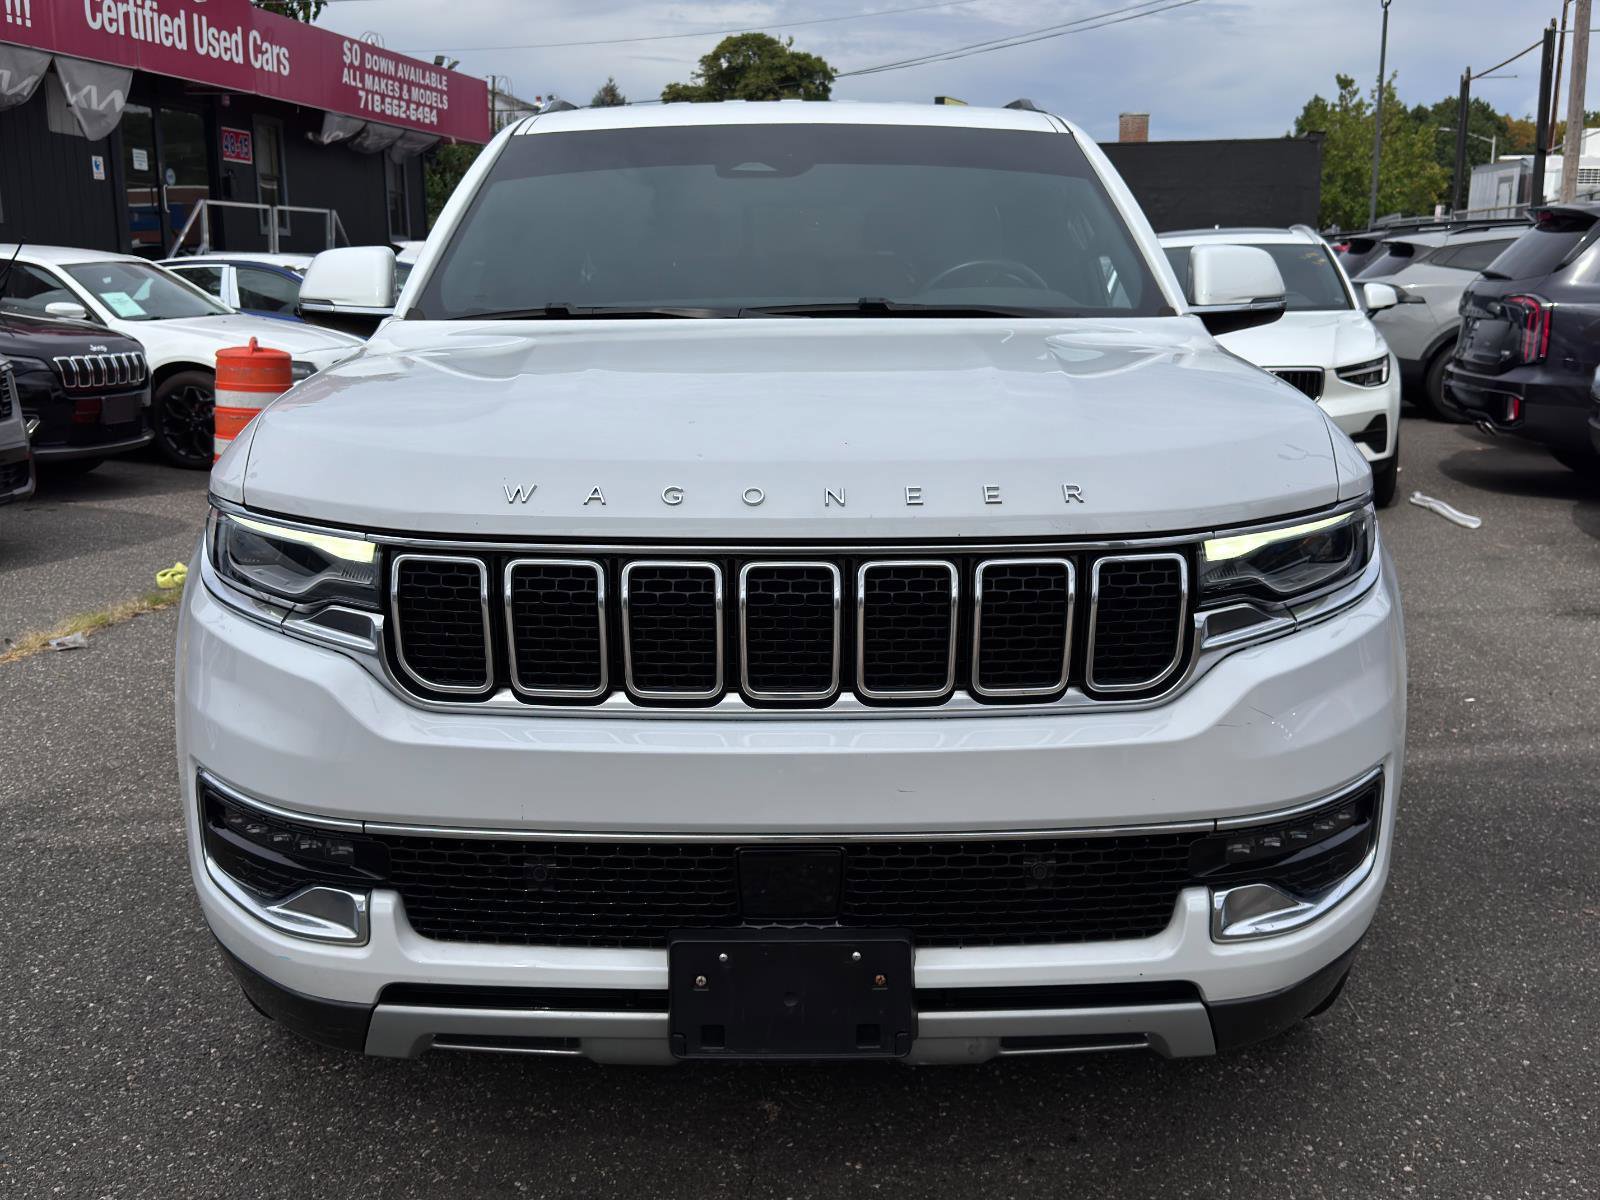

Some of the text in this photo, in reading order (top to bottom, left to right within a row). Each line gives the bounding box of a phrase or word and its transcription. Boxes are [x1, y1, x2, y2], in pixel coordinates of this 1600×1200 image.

[83, 0, 290, 76] Certified Used Cars
[342, 39, 449, 91] $0 DOWN AVAILABLE
[342, 67, 449, 110] ALL MAKES & MODELS
[503, 483, 1085, 506] WAGONEER
